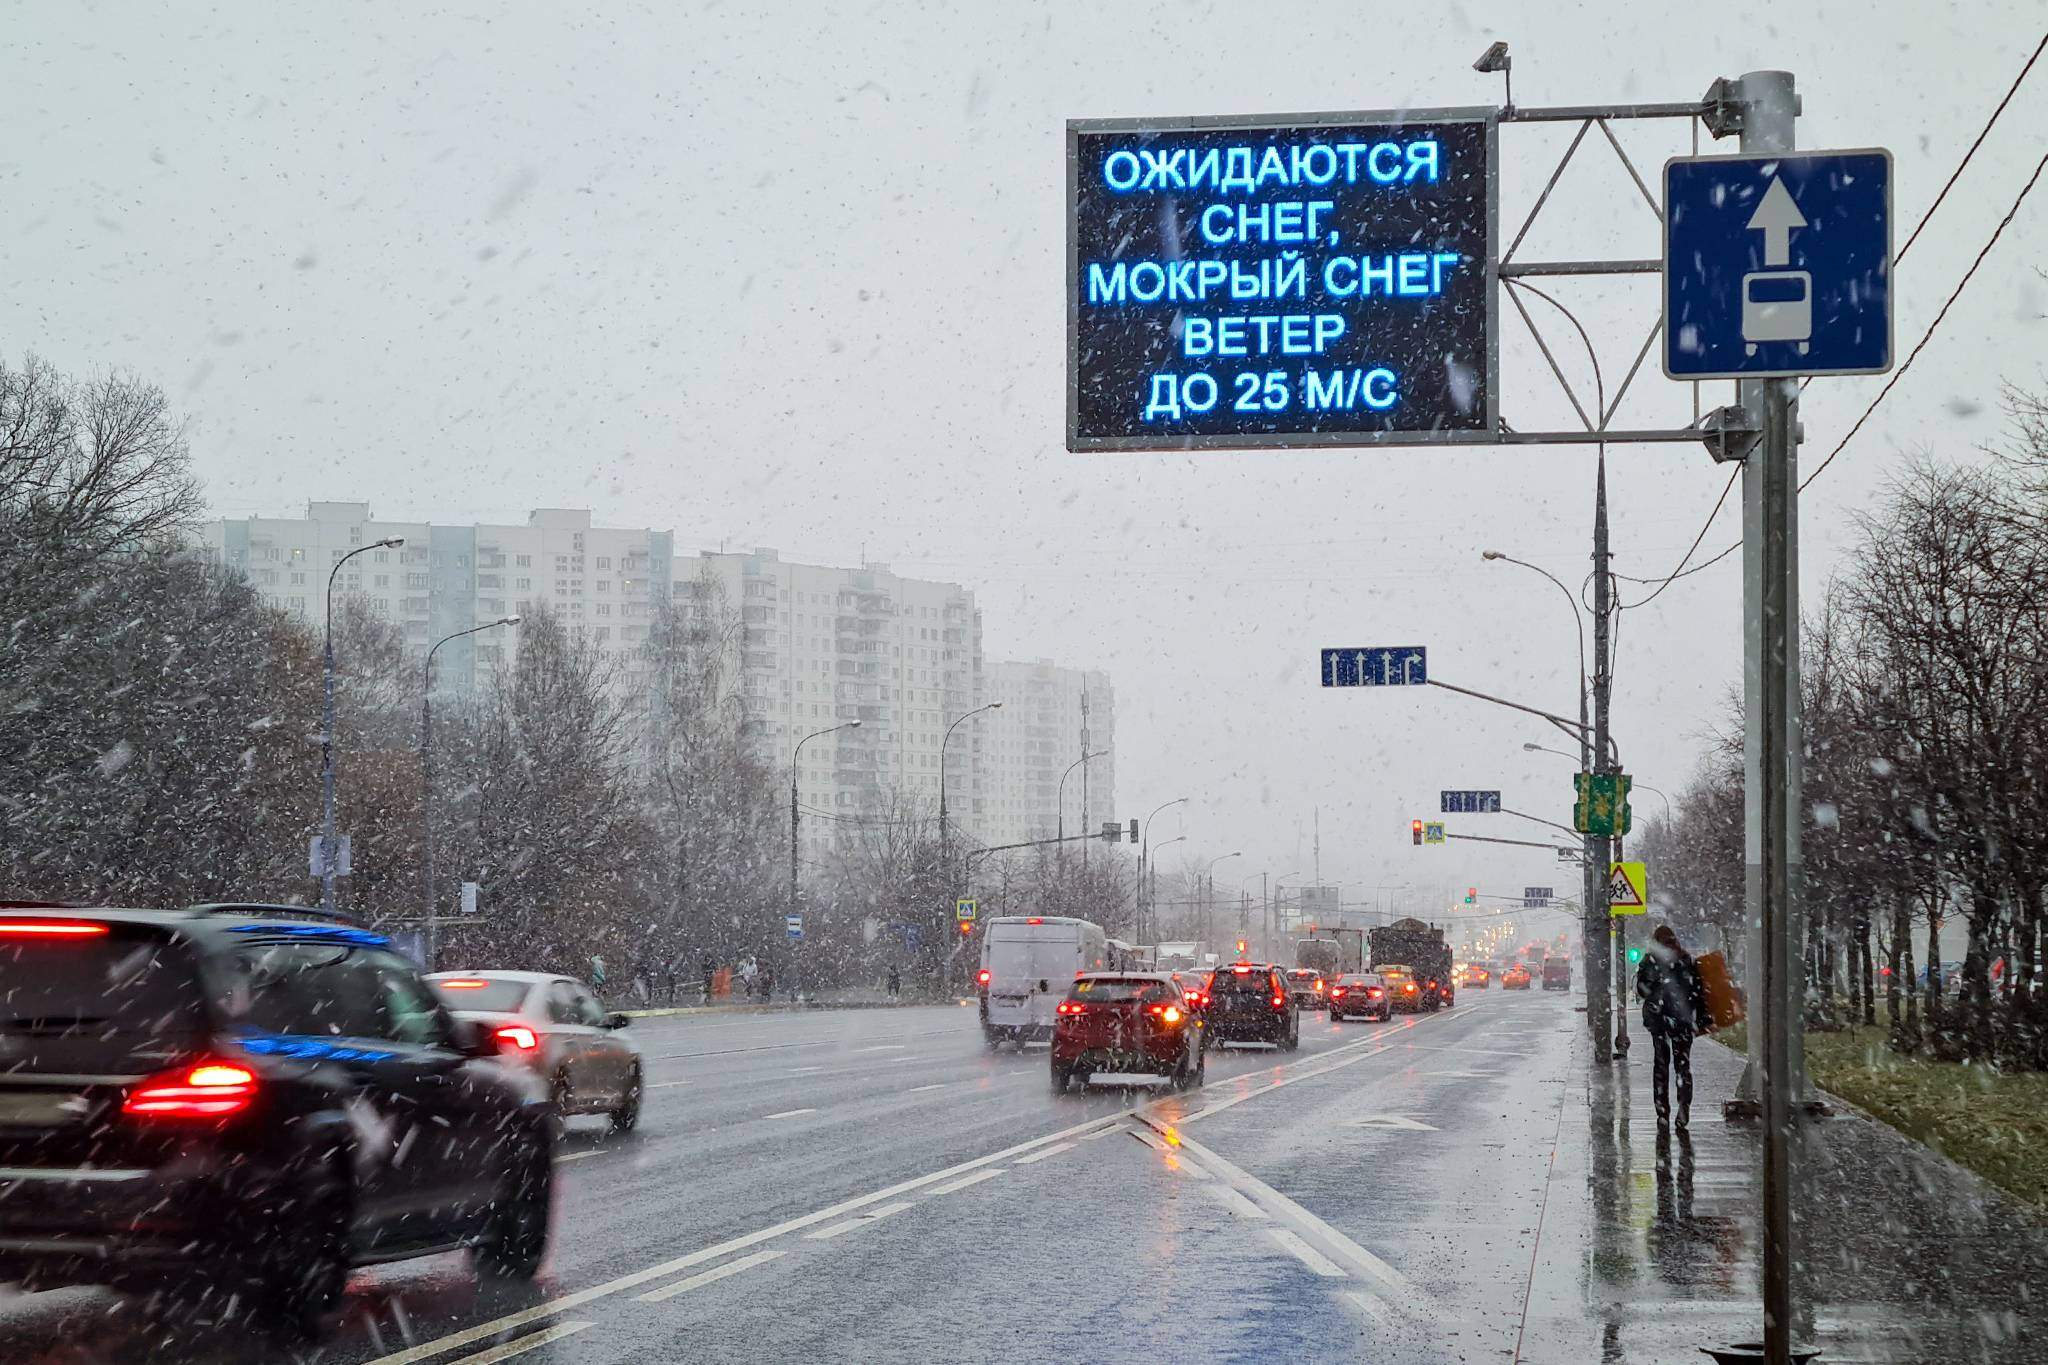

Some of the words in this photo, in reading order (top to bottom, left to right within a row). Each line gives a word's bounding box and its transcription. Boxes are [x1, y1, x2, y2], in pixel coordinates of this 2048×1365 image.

[1104, 141, 1438, 194] ОЖИДАЮТСЯ
[1201, 201, 1339, 245] СНЕГ,
[1088, 250, 1306, 303] МОКРЫЙ
[1324, 254, 1458, 297] СНЕГ
[1183, 314, 1346, 356] ВЕТЕР
[1145, 372, 1219, 420] ДО
[1234, 371, 1289, 411] 25
[1306, 368, 1397, 409] М/С
